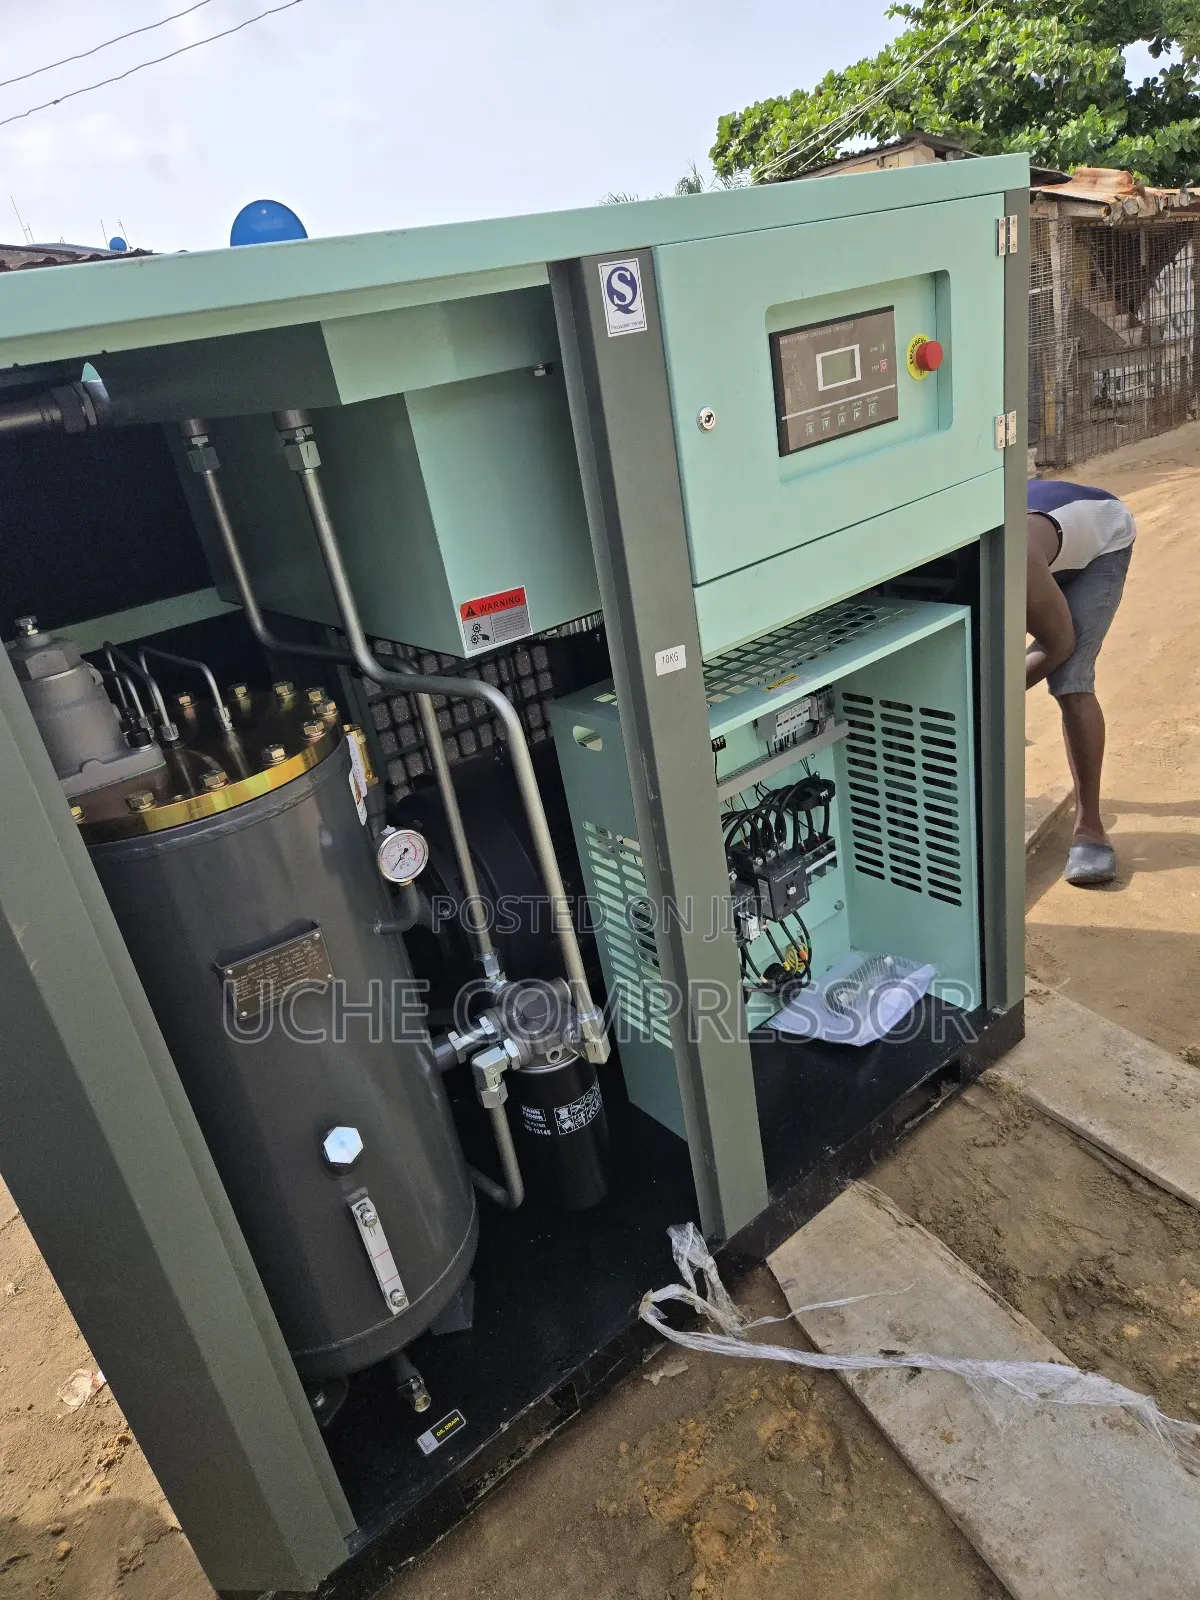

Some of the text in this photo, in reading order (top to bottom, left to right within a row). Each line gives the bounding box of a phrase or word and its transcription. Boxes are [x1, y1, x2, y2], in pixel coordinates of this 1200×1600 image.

[479, 595, 521, 613] WARNING
[661, 652, 679, 666] 10KG
[444, 1416, 460, 1430] DRAIN
